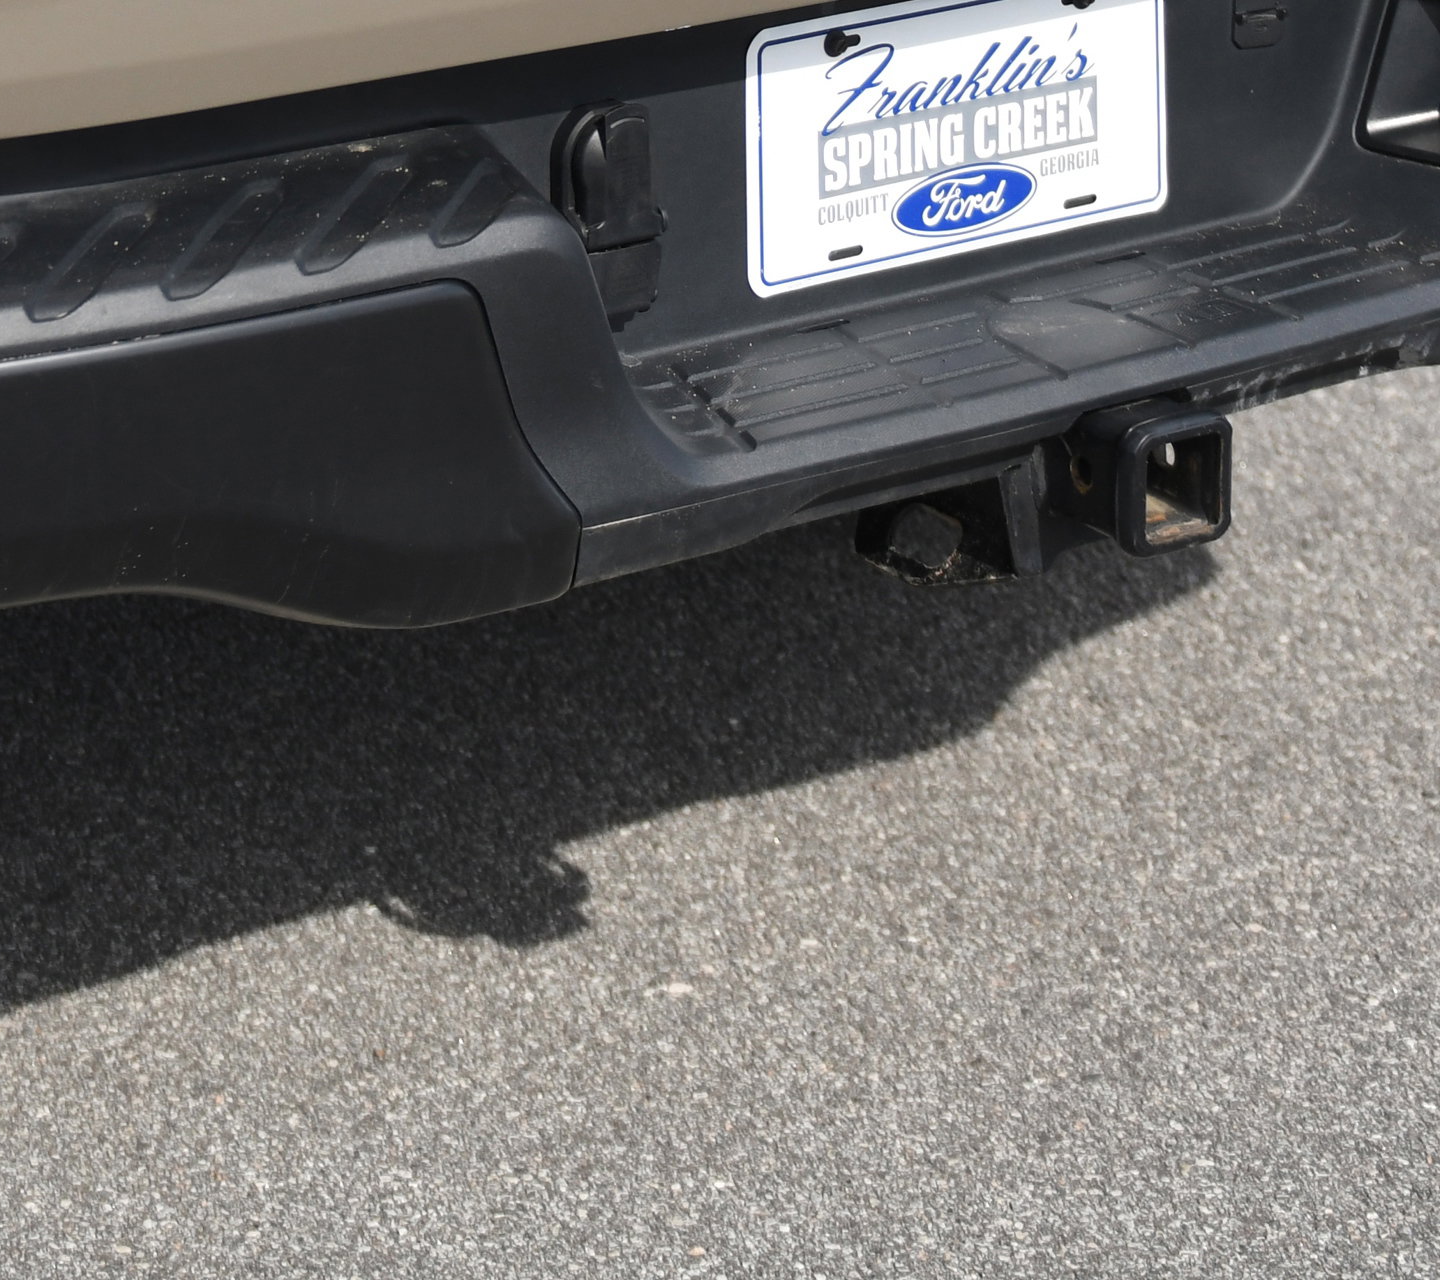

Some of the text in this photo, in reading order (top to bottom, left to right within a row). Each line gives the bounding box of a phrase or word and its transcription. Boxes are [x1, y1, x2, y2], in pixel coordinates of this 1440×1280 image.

[820, 22, 1096, 137] Franklin's
[823, 87, 1095, 193] SPRING CREEK
[1039, 148, 1100, 178] GEORGIA
[817, 193, 889, 227] COLQUITT
[923, 174, 1007, 228] Ford
